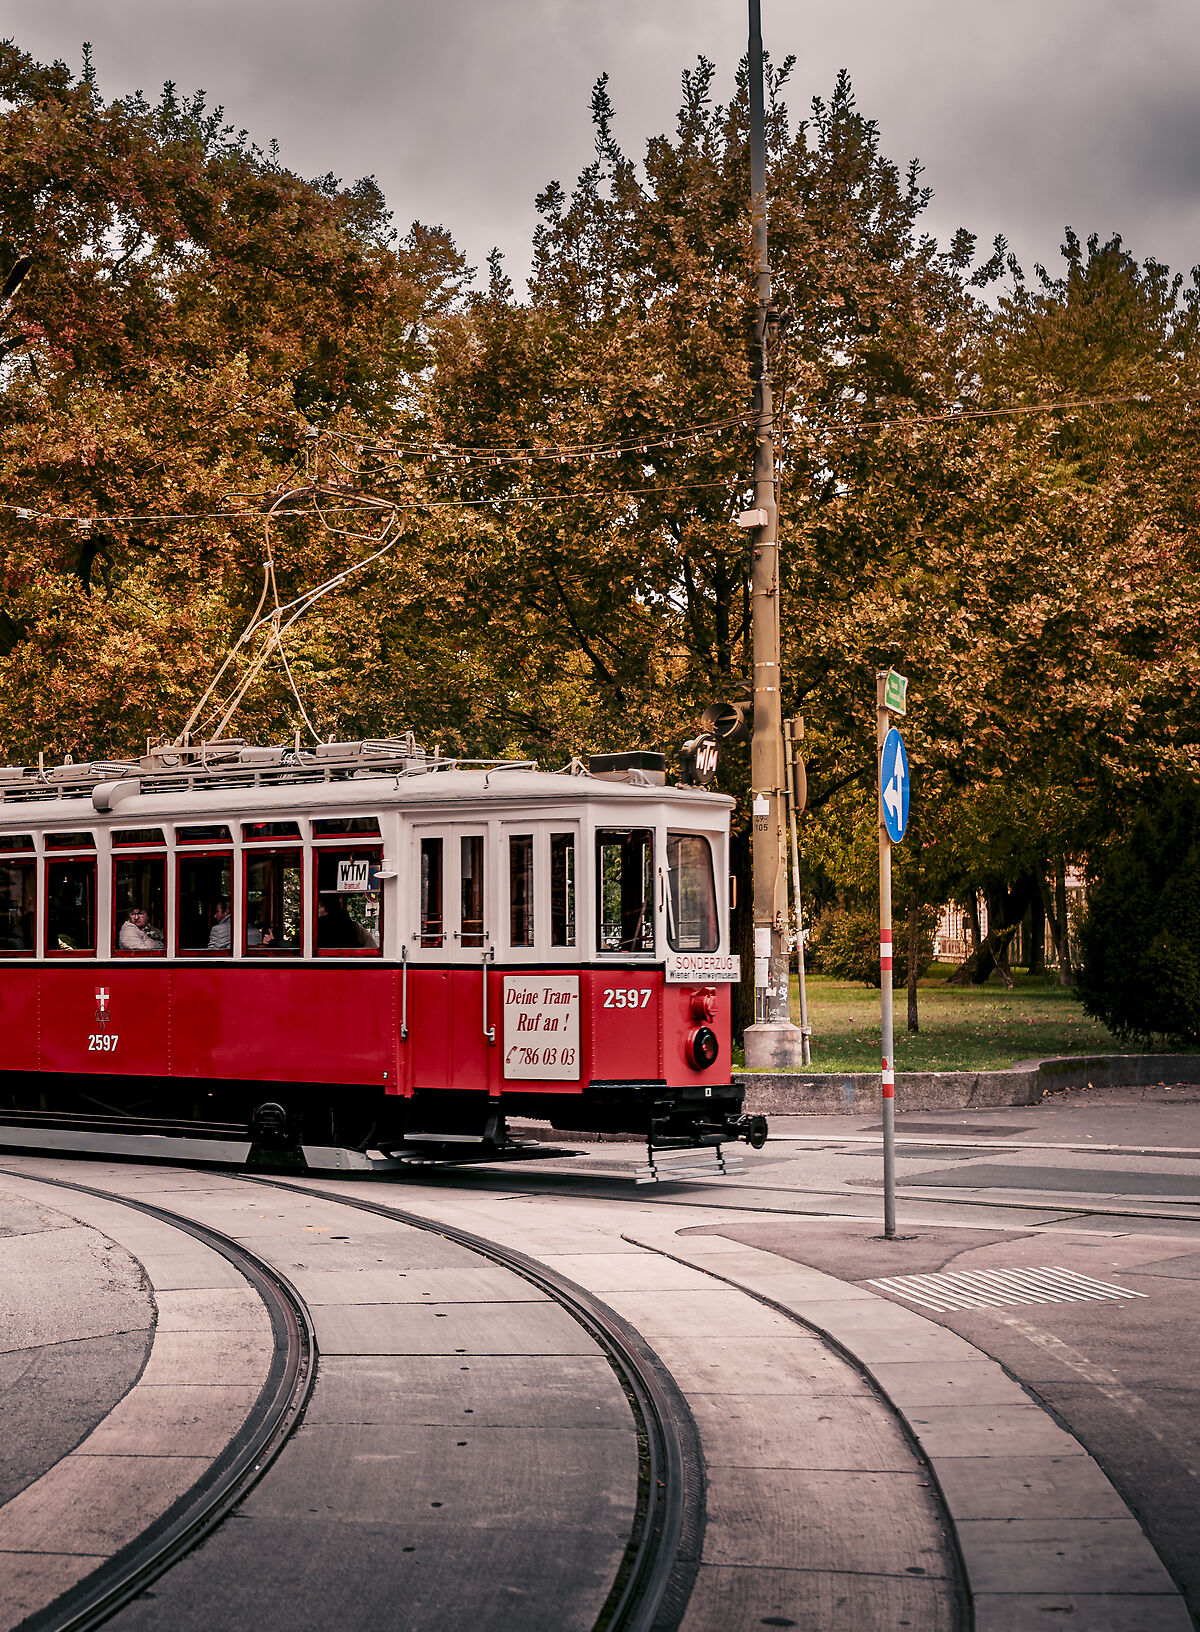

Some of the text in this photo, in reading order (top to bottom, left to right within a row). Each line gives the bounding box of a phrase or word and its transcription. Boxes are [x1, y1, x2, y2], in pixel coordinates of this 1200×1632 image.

[340, 864, 367, 881] WTM
[675, 956, 734, 970] SONDERZUG
[669, 969, 691, 980] Wiener
[505, 987, 579, 1005] Deine Tram-
[603, 988, 652, 1008] 2597
[517, 1012, 542, 1032] Ruf
[543, 1017, 559, 1032] an
[88, 1034, 119, 1052] 2597
[518, 1047, 576, 1066] 786 03 03
